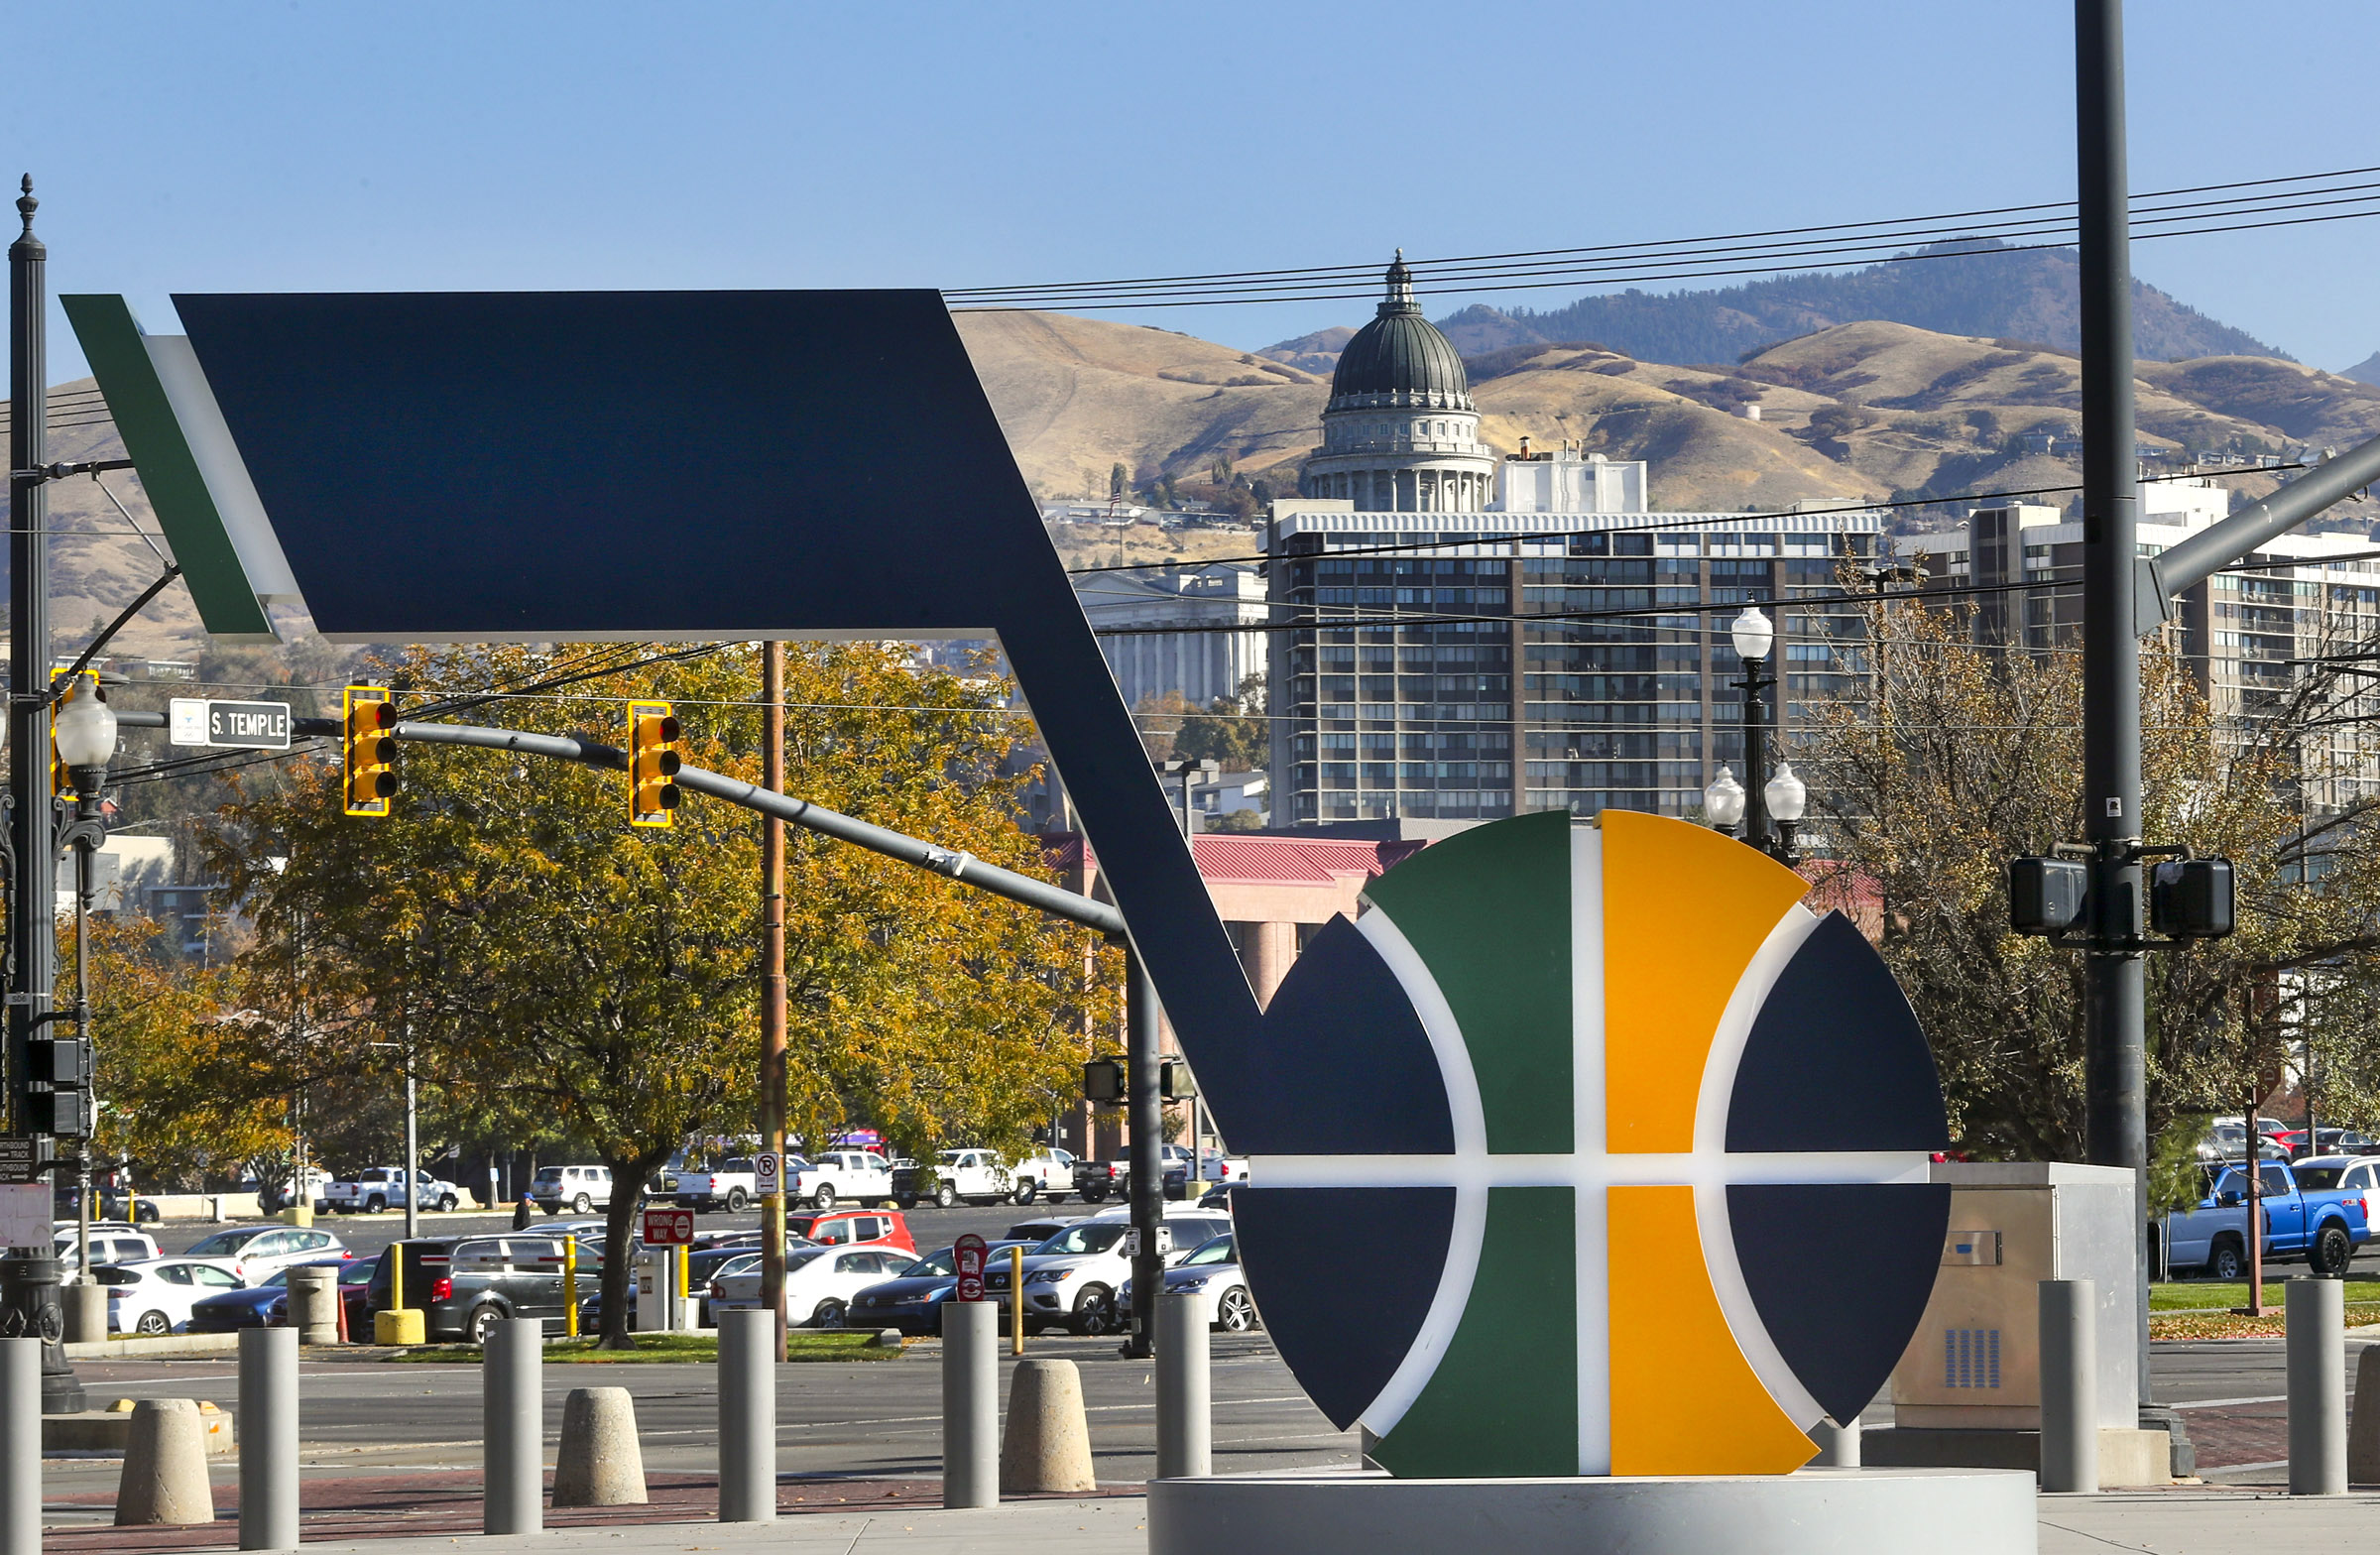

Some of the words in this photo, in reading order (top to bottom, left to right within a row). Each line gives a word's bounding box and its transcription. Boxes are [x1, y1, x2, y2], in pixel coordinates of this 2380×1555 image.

[211, 711, 224, 735] S.
[228, 712, 286, 737] TEMPLE
[647, 1214, 673, 1227] WRONG
[653, 1228, 668, 1241] WAY
